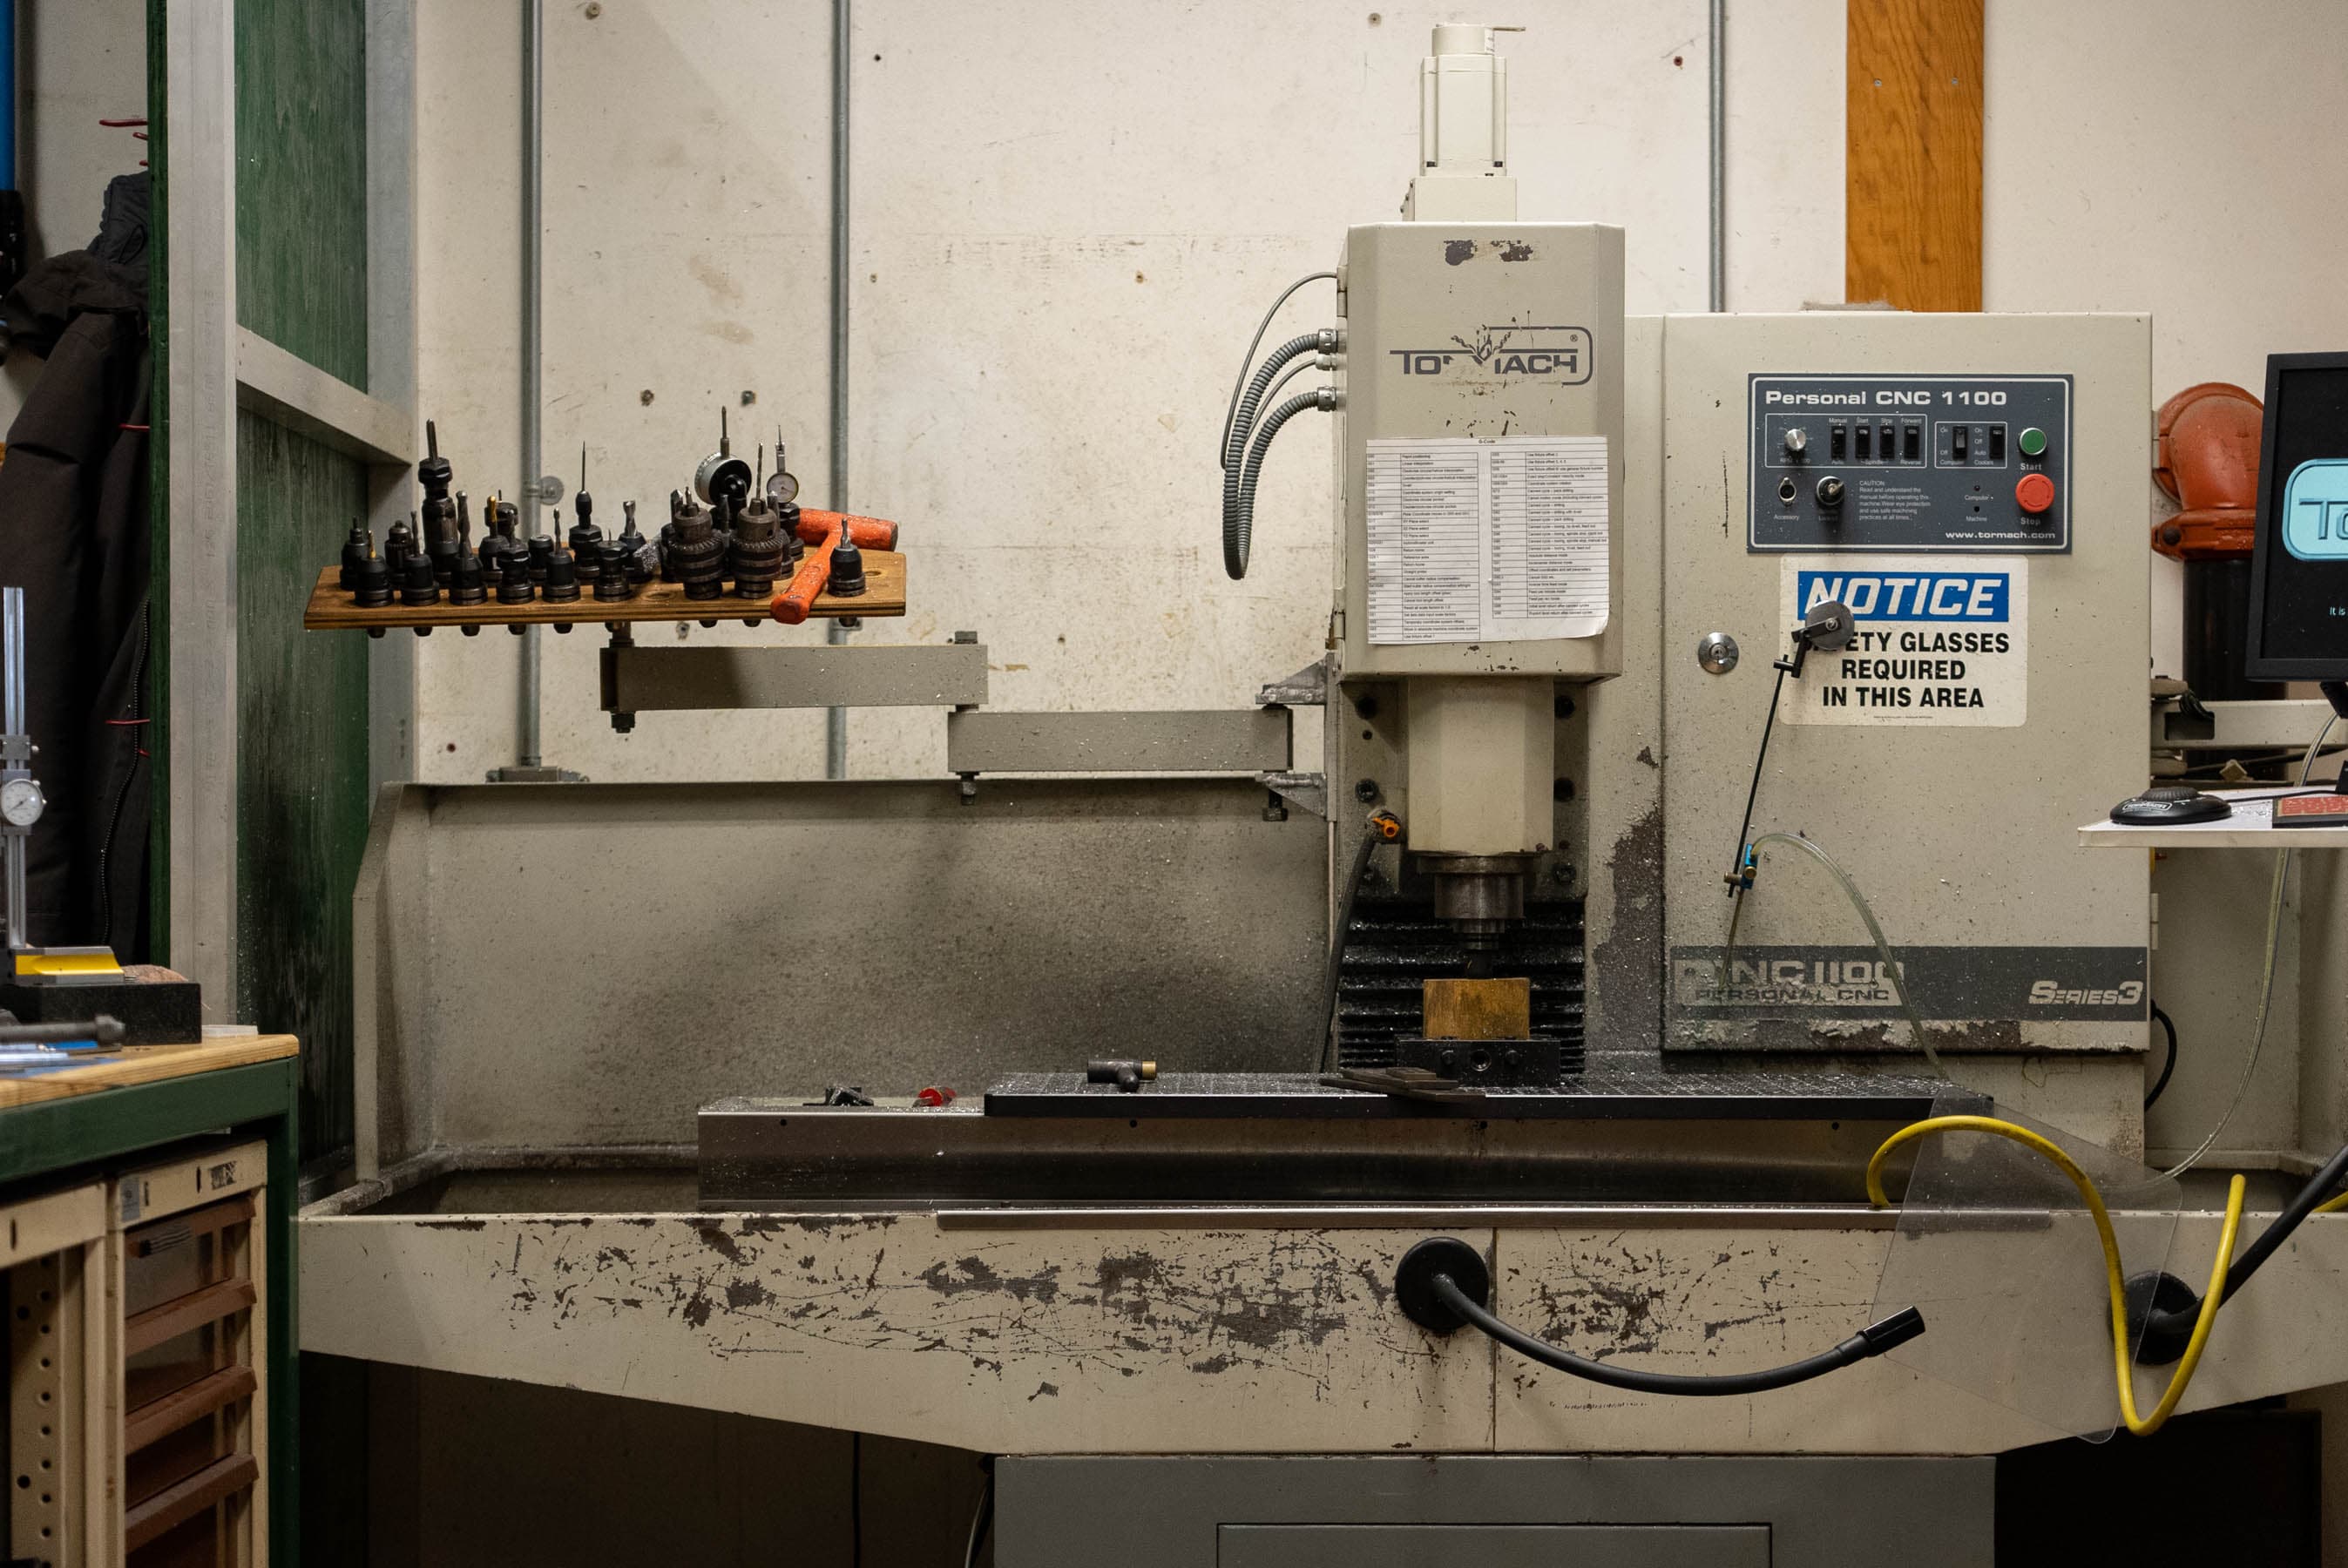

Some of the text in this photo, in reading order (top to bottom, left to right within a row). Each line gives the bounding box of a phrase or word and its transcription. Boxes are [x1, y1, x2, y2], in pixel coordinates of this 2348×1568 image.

[1765, 390, 2007, 405] Personal CNC 1100
[2020, 517, 2041, 526] Stop
[1945, 531, 2056, 540] www.tormach.com
[1804, 577, 2002, 616] NOTICE
[1900, 632, 2009, 652] GLASSES
[1842, 659, 1966, 680] REQUIRED
[1823, 686, 1985, 707] IN THIS AREA
[1837, 990, 1889, 1001] CNC
